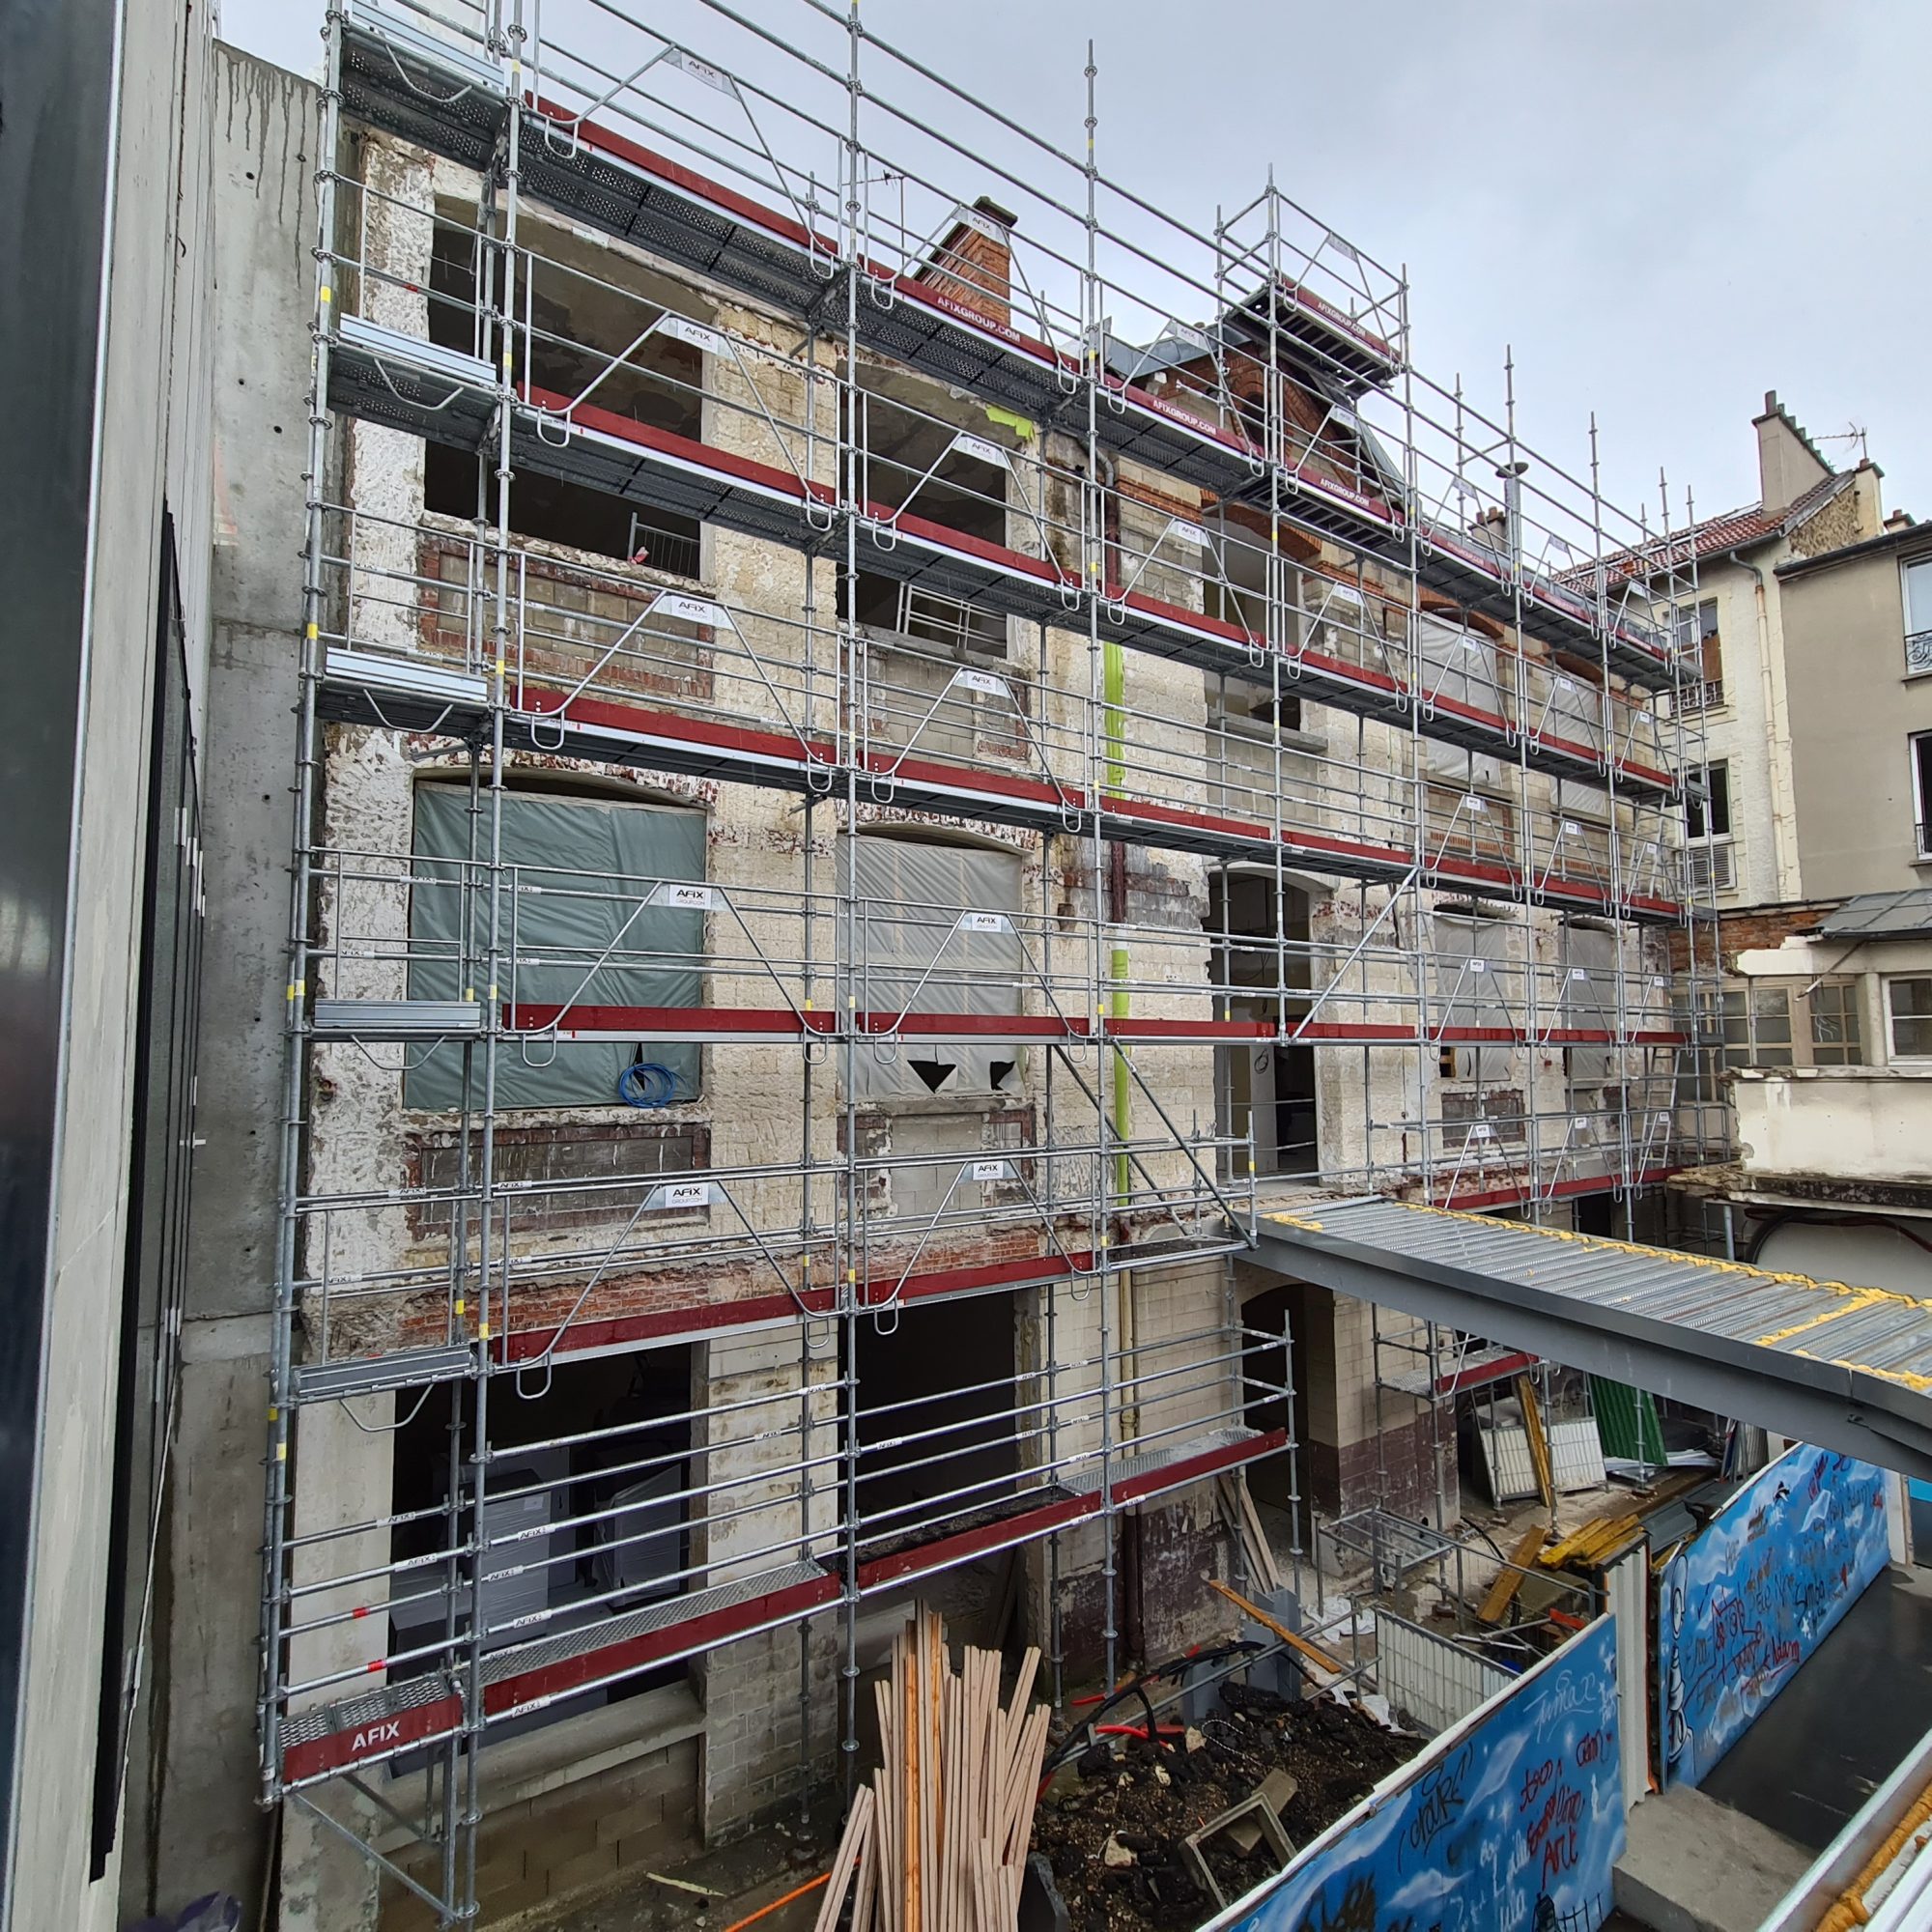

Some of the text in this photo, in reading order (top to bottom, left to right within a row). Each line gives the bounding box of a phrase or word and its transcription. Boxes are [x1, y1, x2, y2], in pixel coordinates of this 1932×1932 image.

[689, 59, 715, 77] AFIX
[937, 297, 1020, 343] AFIXGROUP.COM
[1317, 301, 1365, 336] AFIXGROUP.COM
[684, 327, 711, 342] AFIX
[1152, 400, 1216, 436] AFIXGROUP.COM
[971, 441, 991, 454] AFIX
[1320, 477, 1369, 507] AFIXGROUP.COM
[678, 601, 705, 612] AFIX
[972, 674, 991, 685] AFIX
[676, 889, 704, 898] AFIX
[672, 1187, 701, 1197] AFIX
[352, 1719, 400, 1751] AFIX
